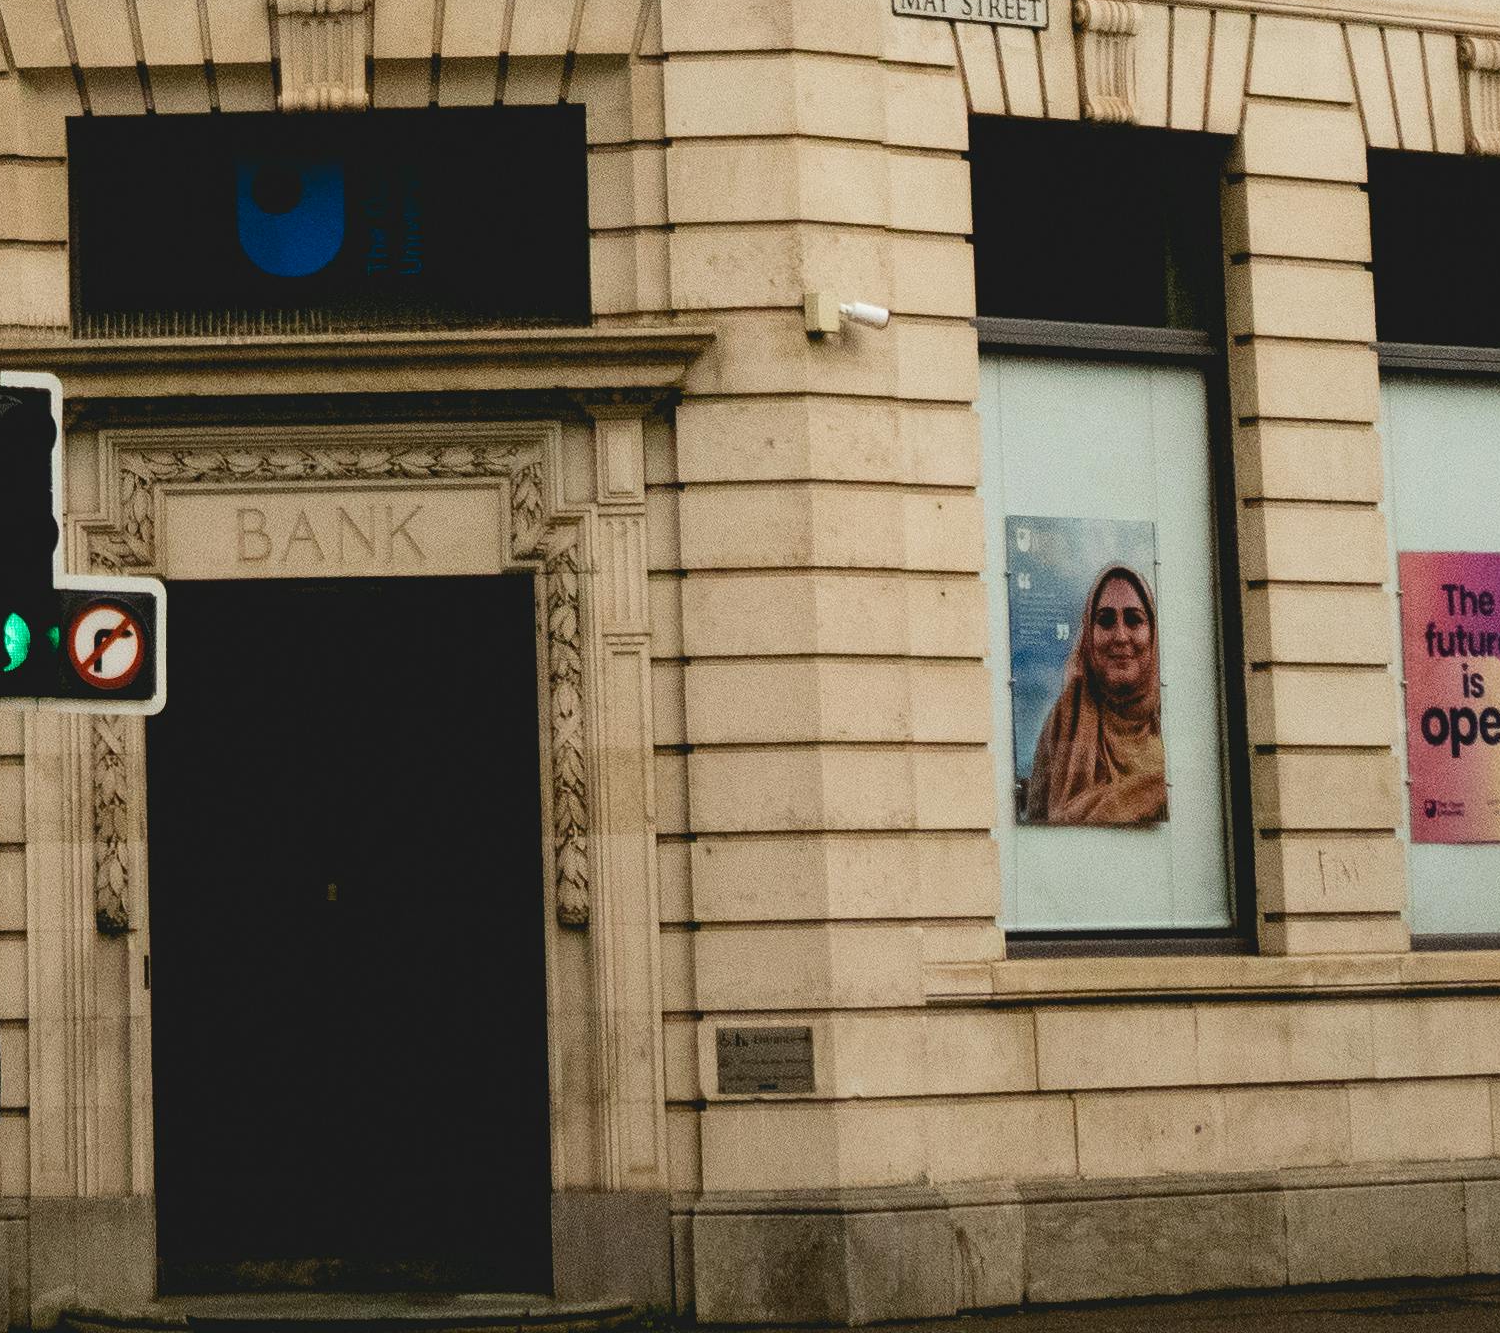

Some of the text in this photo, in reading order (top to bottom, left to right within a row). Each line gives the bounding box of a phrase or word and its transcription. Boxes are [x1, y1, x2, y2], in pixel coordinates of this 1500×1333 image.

[236, 503, 429, 566] BANK
[1442, 584, 1496, 617] The
[1461, 662, 1485, 699] is
